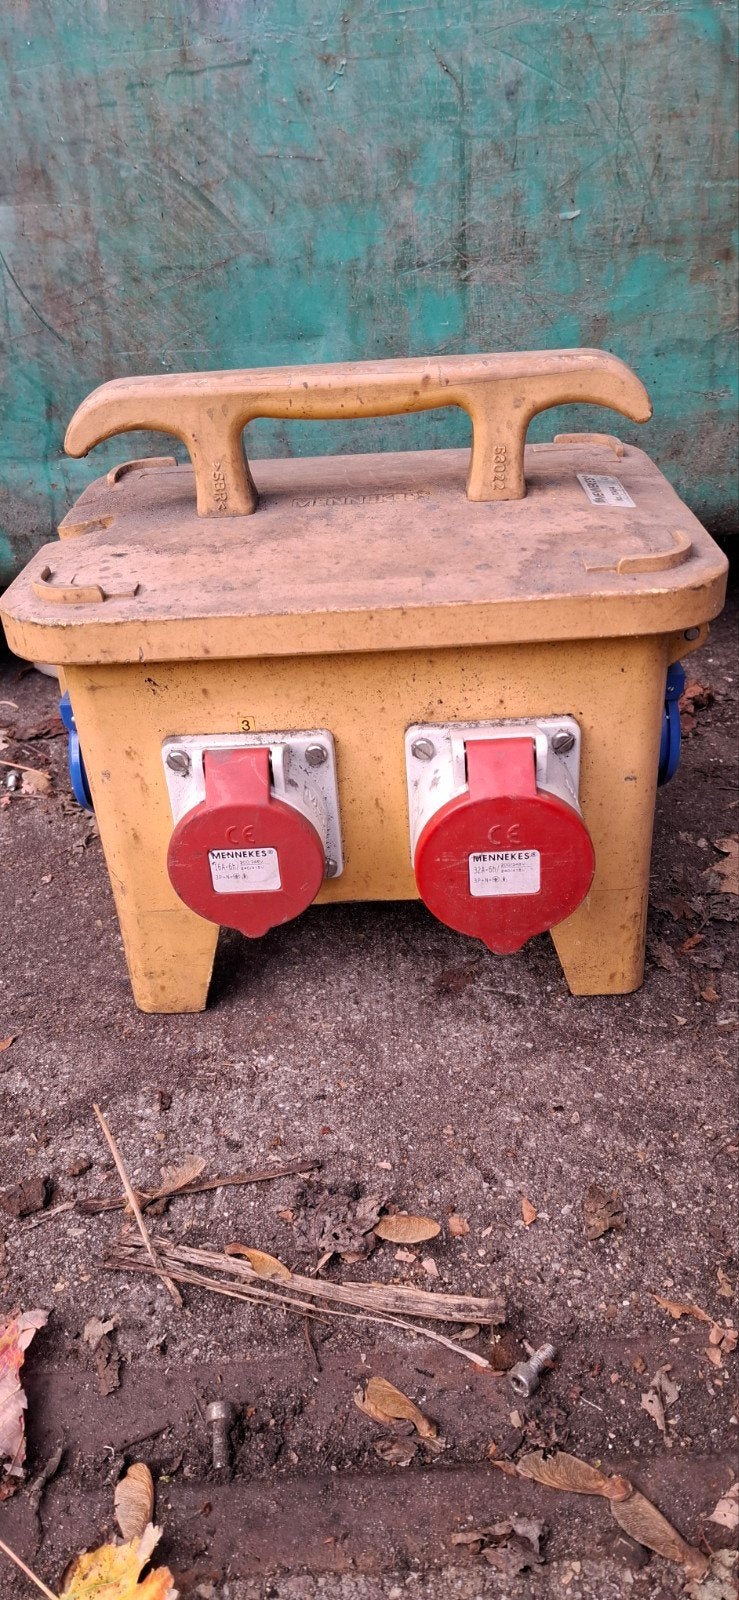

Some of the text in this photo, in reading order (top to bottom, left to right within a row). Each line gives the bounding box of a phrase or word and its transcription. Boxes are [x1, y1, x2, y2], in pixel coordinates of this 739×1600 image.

[241, 719, 251, 731] 3
[225, 824, 255, 845] CE
[487, 823, 521, 845] CE
